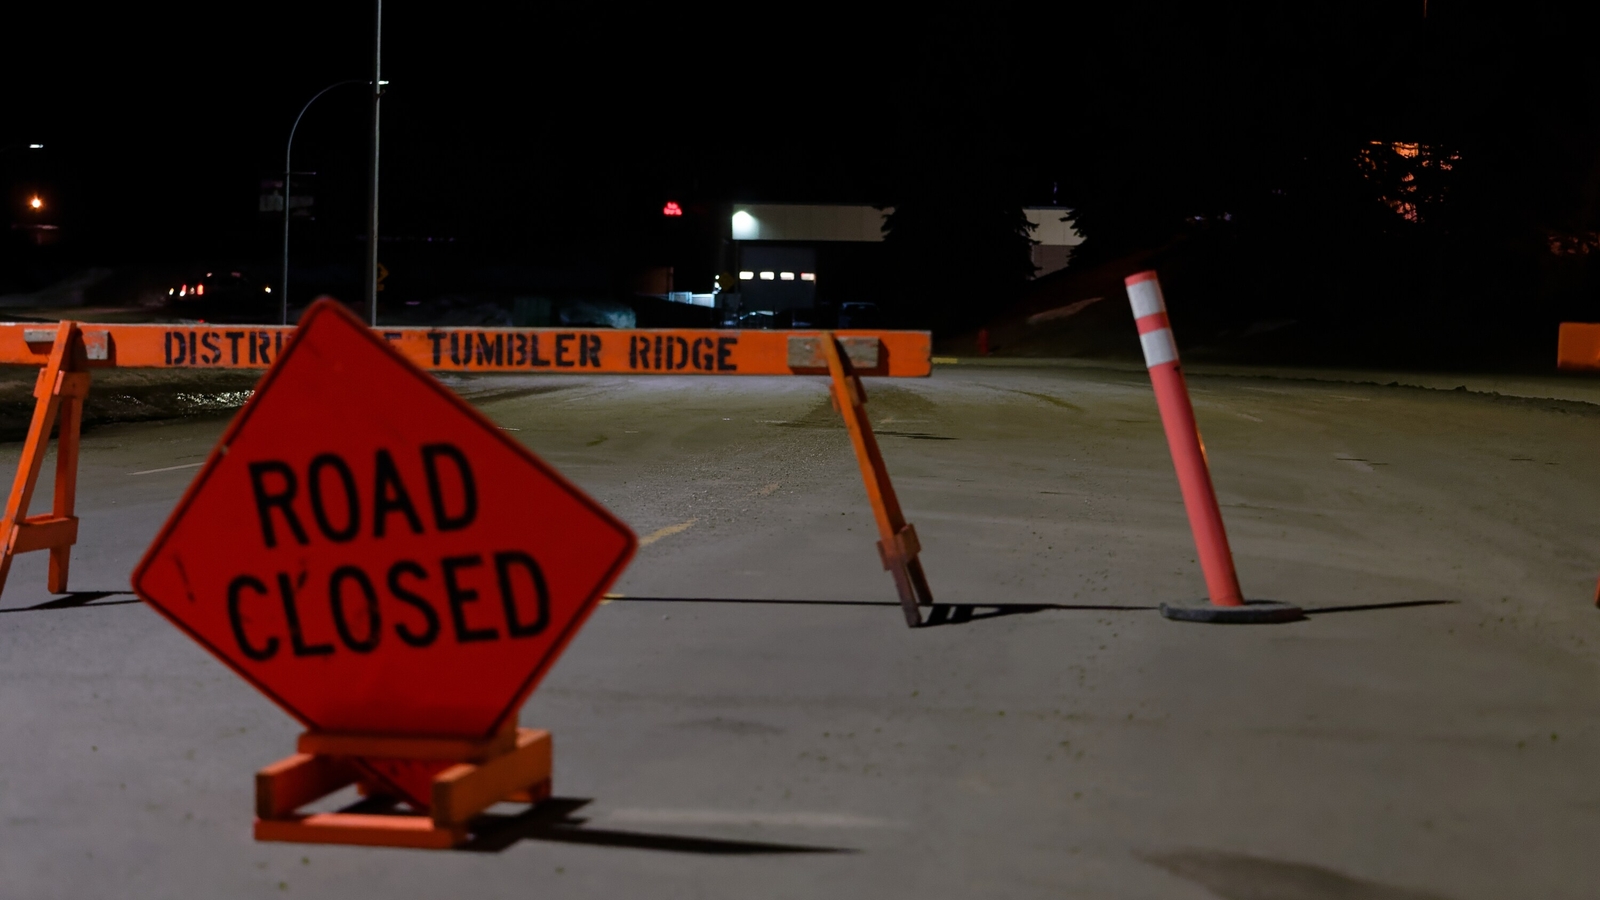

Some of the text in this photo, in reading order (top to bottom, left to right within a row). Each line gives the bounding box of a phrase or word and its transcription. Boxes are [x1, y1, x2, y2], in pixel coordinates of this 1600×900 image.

[165, 331, 738, 371] DISTRI TUMBLER RIDGE
[248, 442, 479, 549] ROAD
[227, 549, 551, 662] CLOSED
